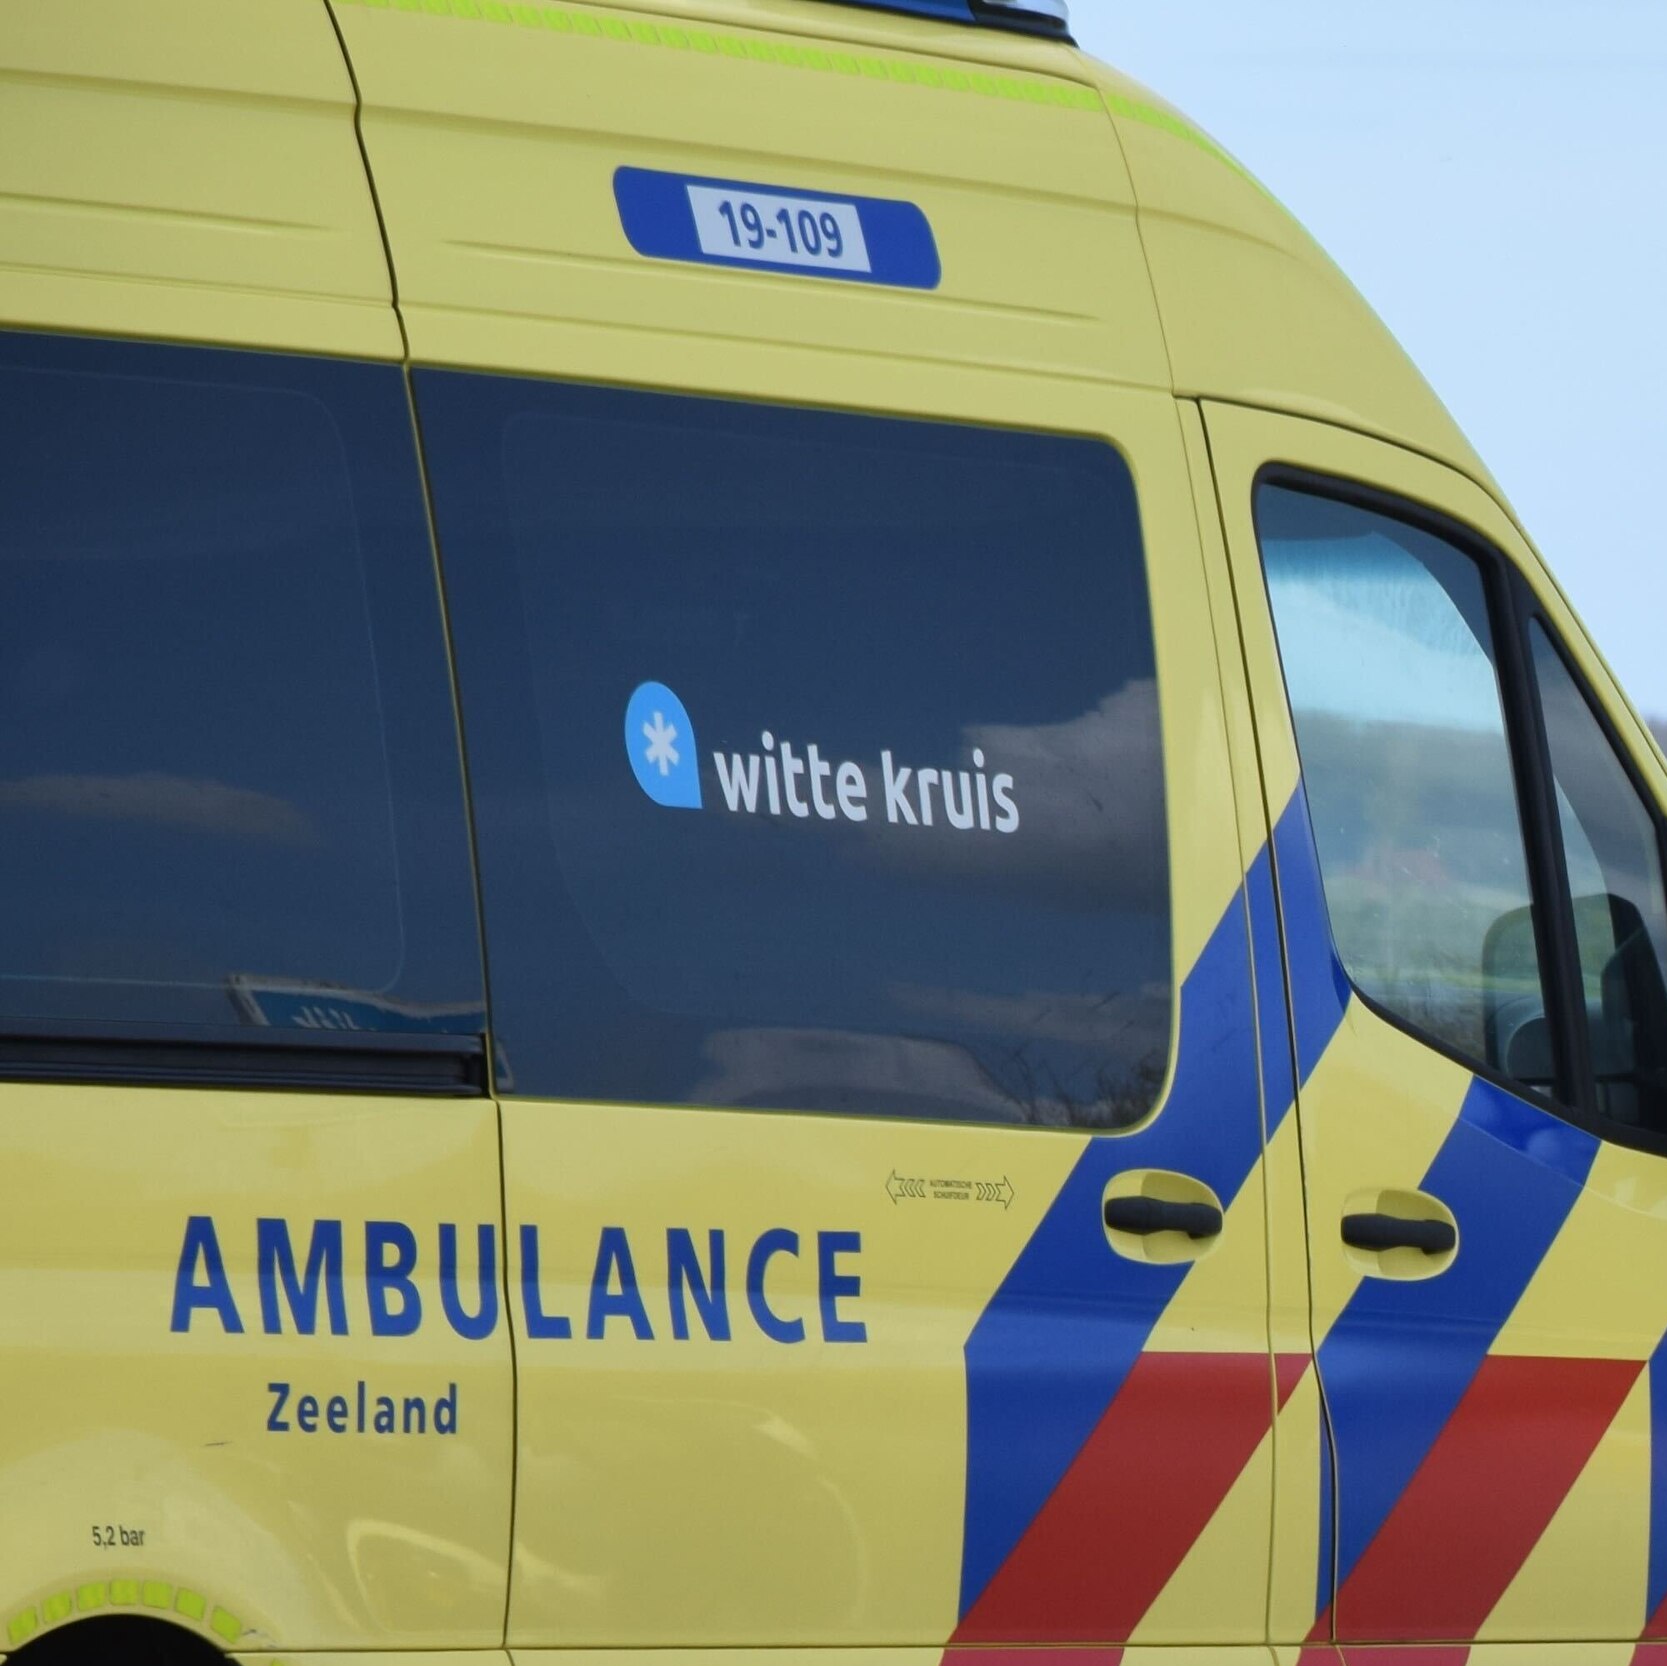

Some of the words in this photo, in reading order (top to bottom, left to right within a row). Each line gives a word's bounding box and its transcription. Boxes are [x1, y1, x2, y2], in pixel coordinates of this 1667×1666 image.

[718, 200, 844, 259] 19-109
[713, 730, 868, 823] witte
[881, 747, 1020, 834] kruis
[170, 1215, 868, 1345] AMBULANCE
[266, 1380, 459, 1435] Zeeland
[92, 1525, 117, 1550] 5,2
[118, 1524, 146, 1547] bar
